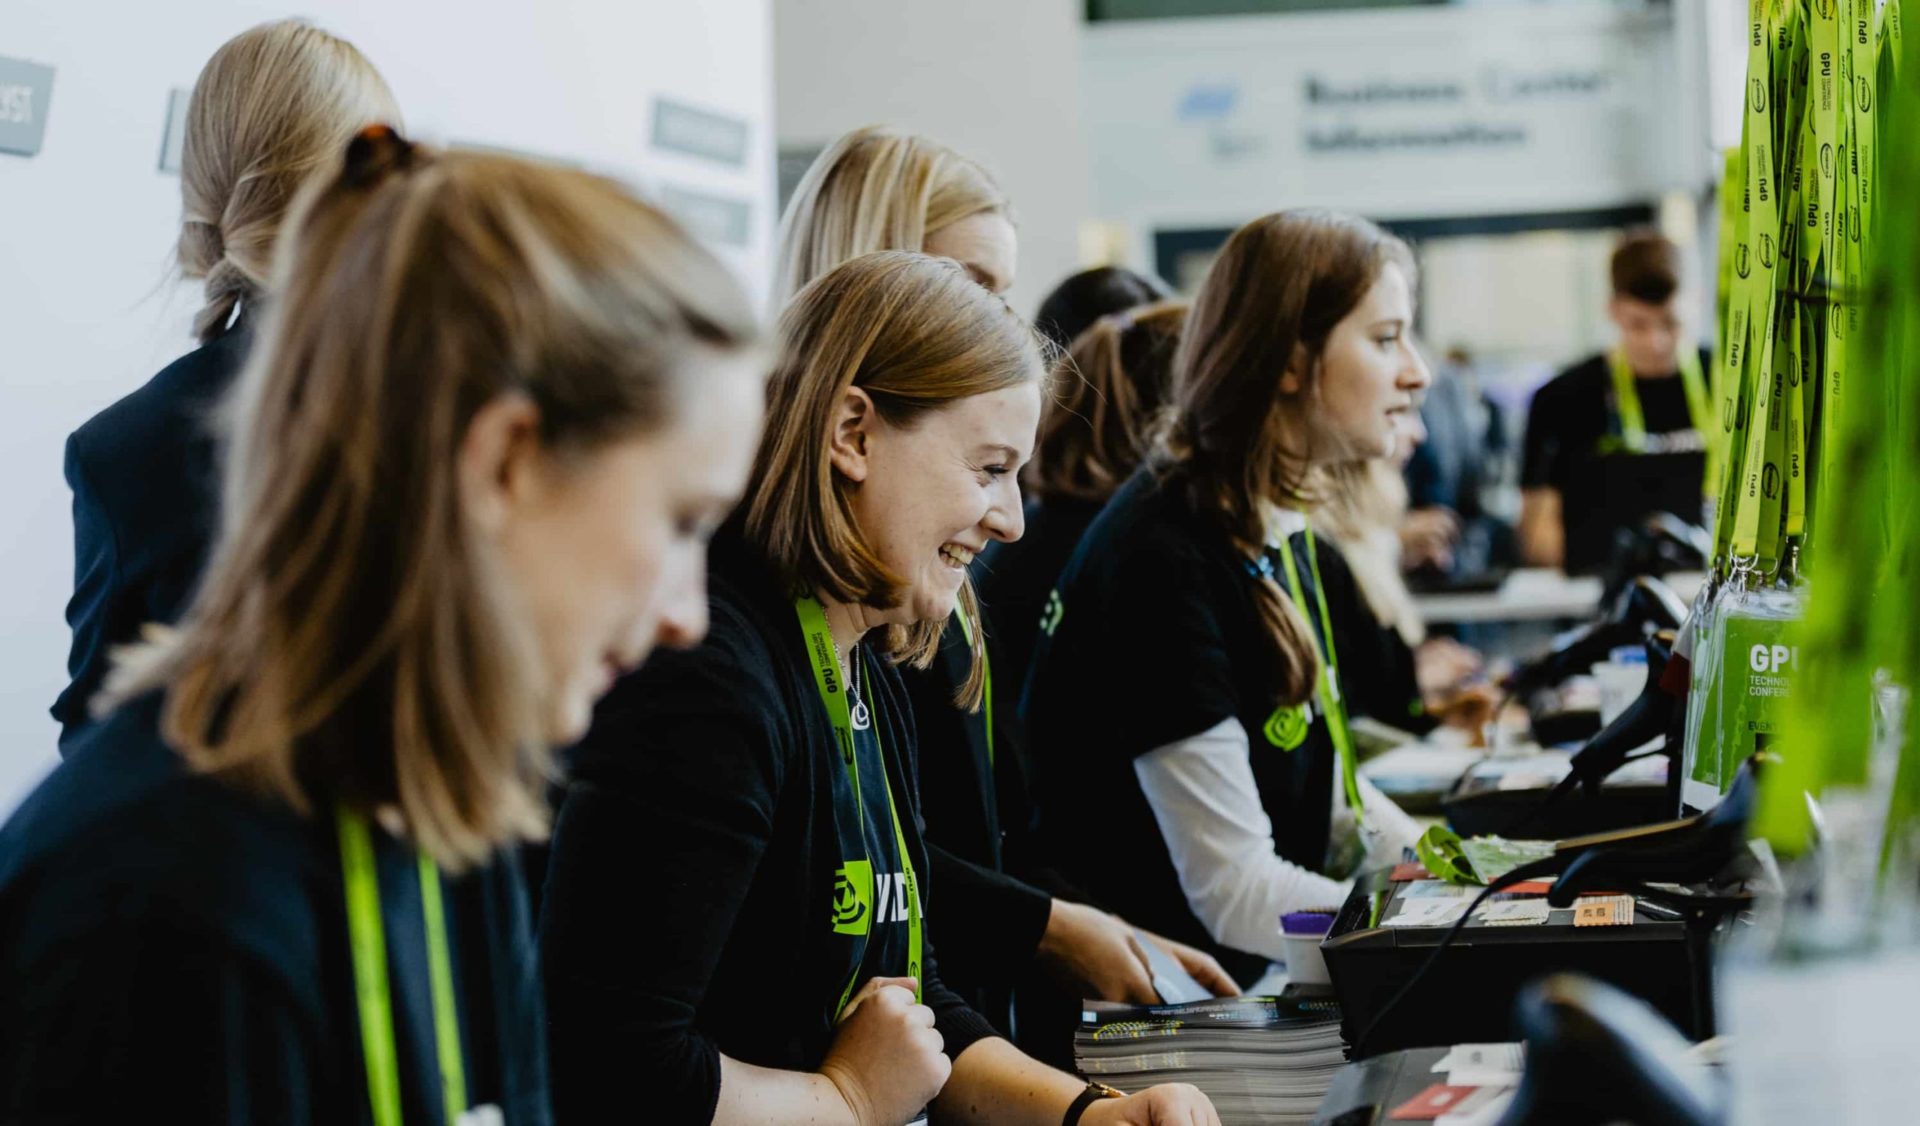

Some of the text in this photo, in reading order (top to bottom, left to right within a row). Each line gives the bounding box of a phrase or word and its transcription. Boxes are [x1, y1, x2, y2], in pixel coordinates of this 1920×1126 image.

[1753, 23, 1762, 46] GPU
[1778, 27, 1788, 50] GPU
[1858, 20, 1868, 44] GPU
[1820, 52, 1831, 76] GPU
[1759, 178, 1768, 201] GPU
[1807, 203, 1818, 227] GPU
[1730, 343, 1740, 367] GPU
[1774, 373, 1783, 397] GPU
[1832, 371, 1840, 395] GPU
[1791, 453, 1799, 478] GPU
[1749, 473, 1758, 497] GPU
[822, 668, 838, 693] GPU
